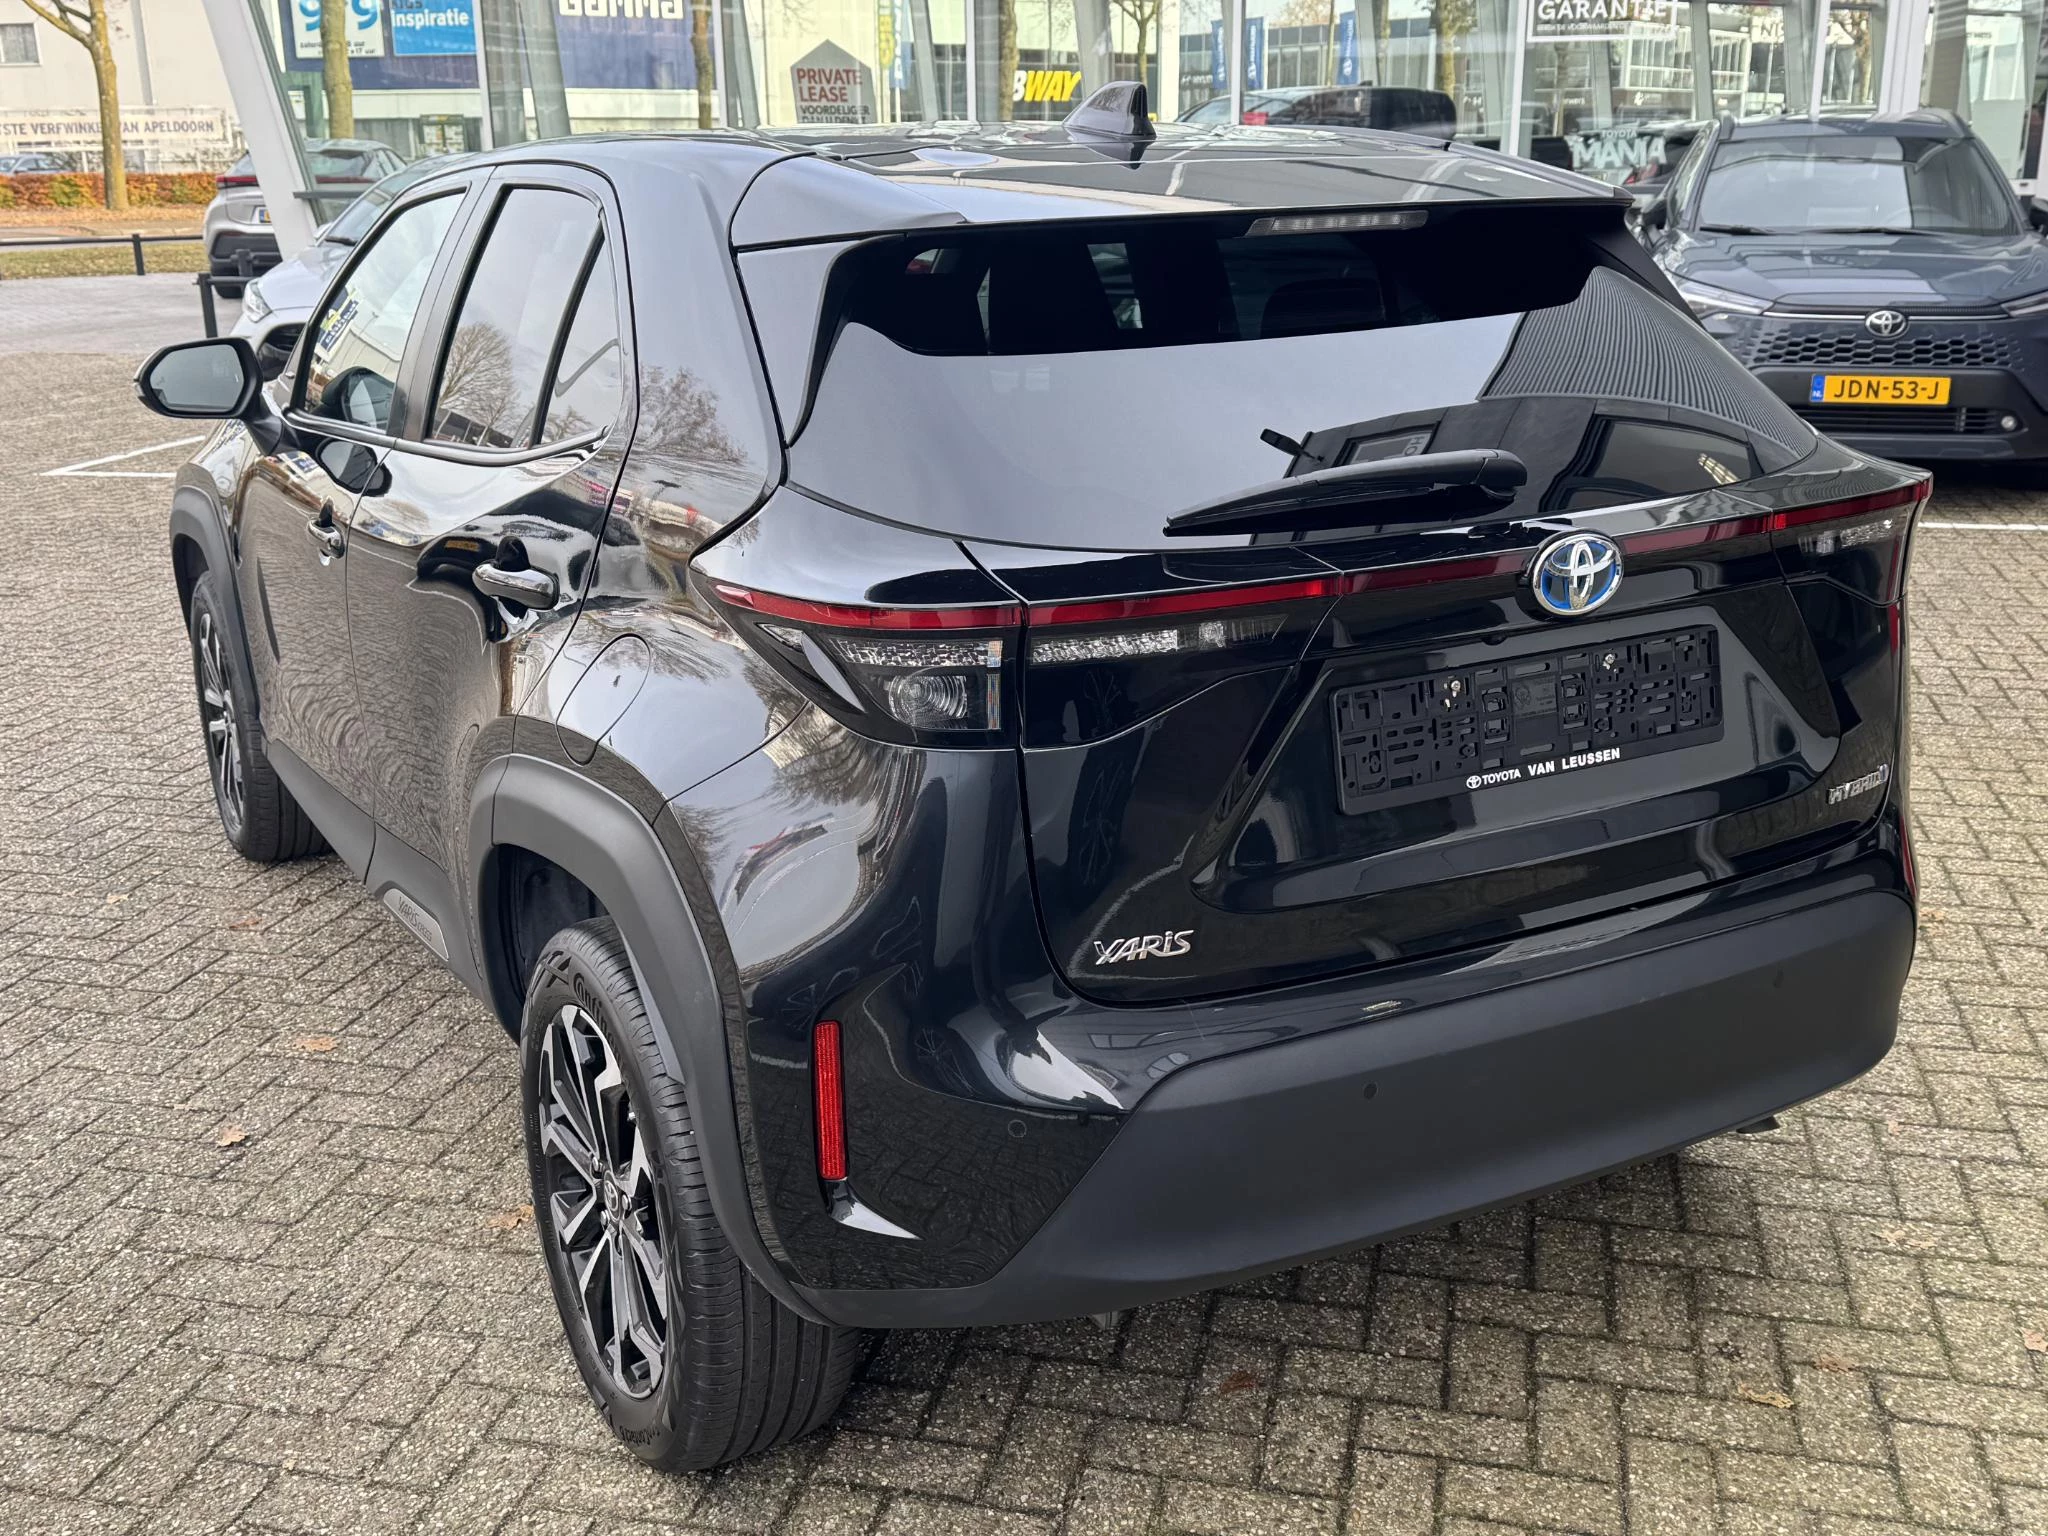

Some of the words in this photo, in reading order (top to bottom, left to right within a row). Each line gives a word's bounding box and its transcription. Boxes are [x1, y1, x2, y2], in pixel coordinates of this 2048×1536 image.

[391, 8, 469, 30] inspiratie
[1538, 0, 1667, 19] GARANTIE
[797, 67, 863, 85] PRIVATE
[799, 86, 848, 102] LEASE
[1013, 70, 1082, 102] BWAY
[800, 104, 871, 116] VOORDELIGER
[30, 122, 103, 134] VERFWINKE
[122, 121, 140, 133] AN
[144, 120, 215, 133] APELDOORN
[1601, 130, 1637, 138] TOYOTA
[1566, 134, 1667, 169] MANIA
[1833, 379, 1940, 400] JDN-53-J
[1482, 768, 1522, 785] TOYOTA
[1528, 760, 1555, 776] VAN
[1562, 747, 1621, 770] LEUSSEN
